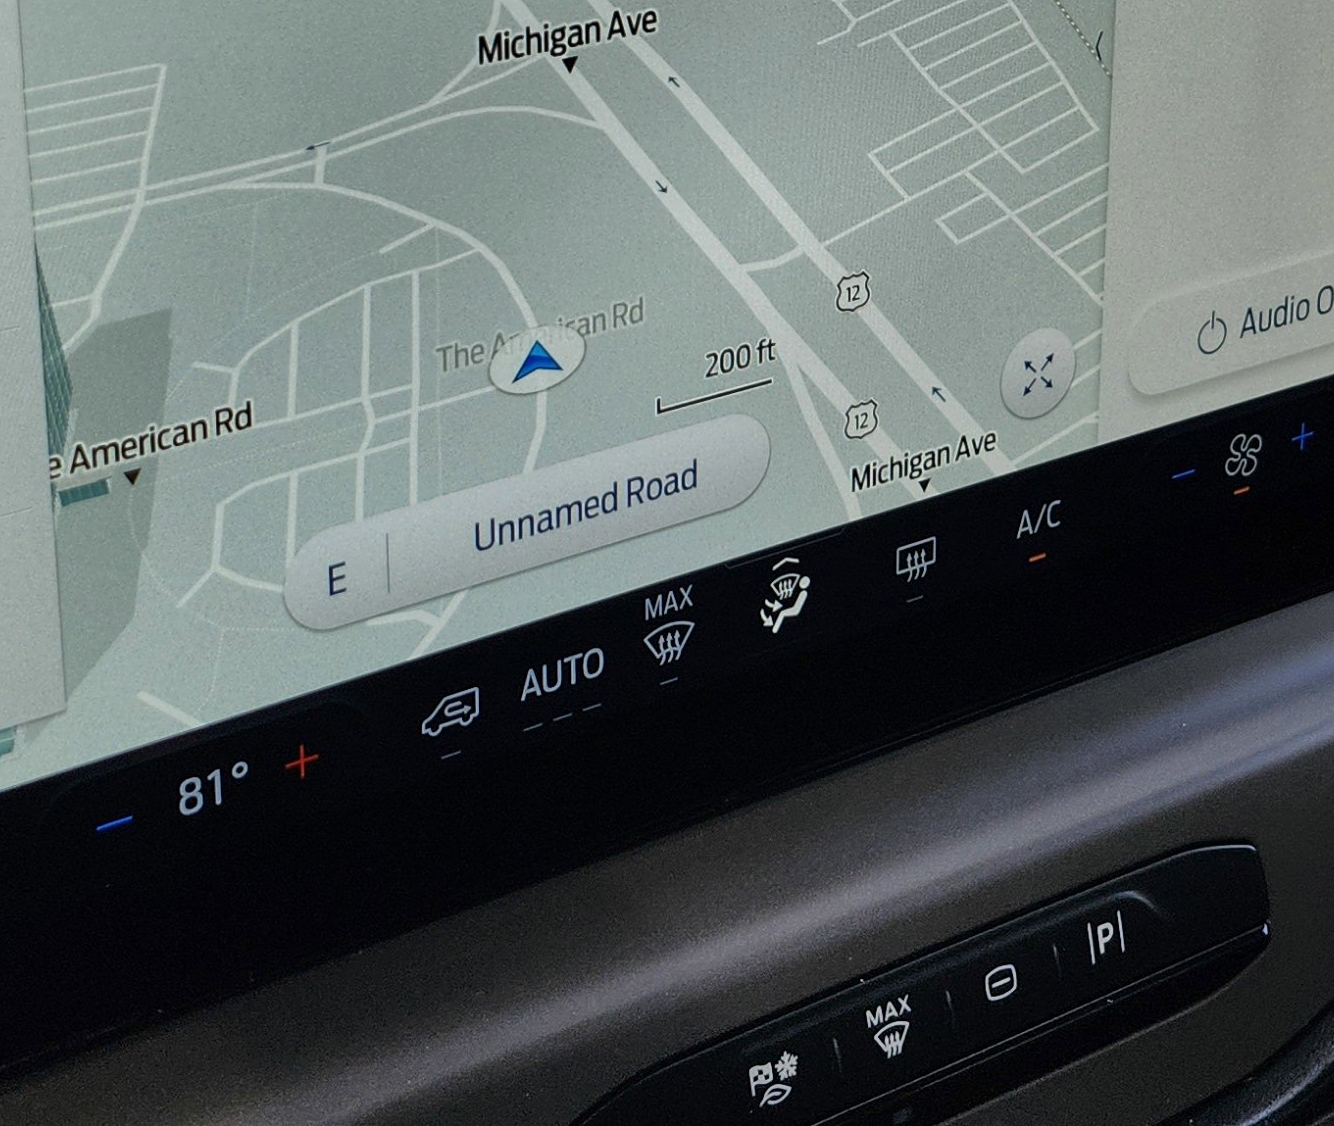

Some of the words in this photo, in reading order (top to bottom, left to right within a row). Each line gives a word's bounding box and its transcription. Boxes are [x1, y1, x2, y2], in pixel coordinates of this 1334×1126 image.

[478, 21, 601, 66] Michigan
[607, 10, 658, 41] Ave
[845, 284, 861, 303] 12
[435, 341, 485, 372] The
[612, 297, 644, 328] Rd
[1238, 295, 1310, 339] Audio
[705, 344, 751, 378] 200
[755, 338, 776, 364] ft
[69, 419, 208, 474] American
[215, 400, 253, 436] Rd
[854, 412, 869, 431] 12
[851, 445, 951, 493] Michigan
[955, 432, 997, 462] Ave
[474, 481, 618, 552] Unnamed
[626, 458, 698, 508] Road
[1016, 499, 1062, 540] A/C
[327, 562, 347, 596] E
[644, 584, 694, 622] MAX
[520, 647, 605, 702] AUTO
[178, 760, 249, 816] 81°
[865, 993, 912, 1029] MAX
